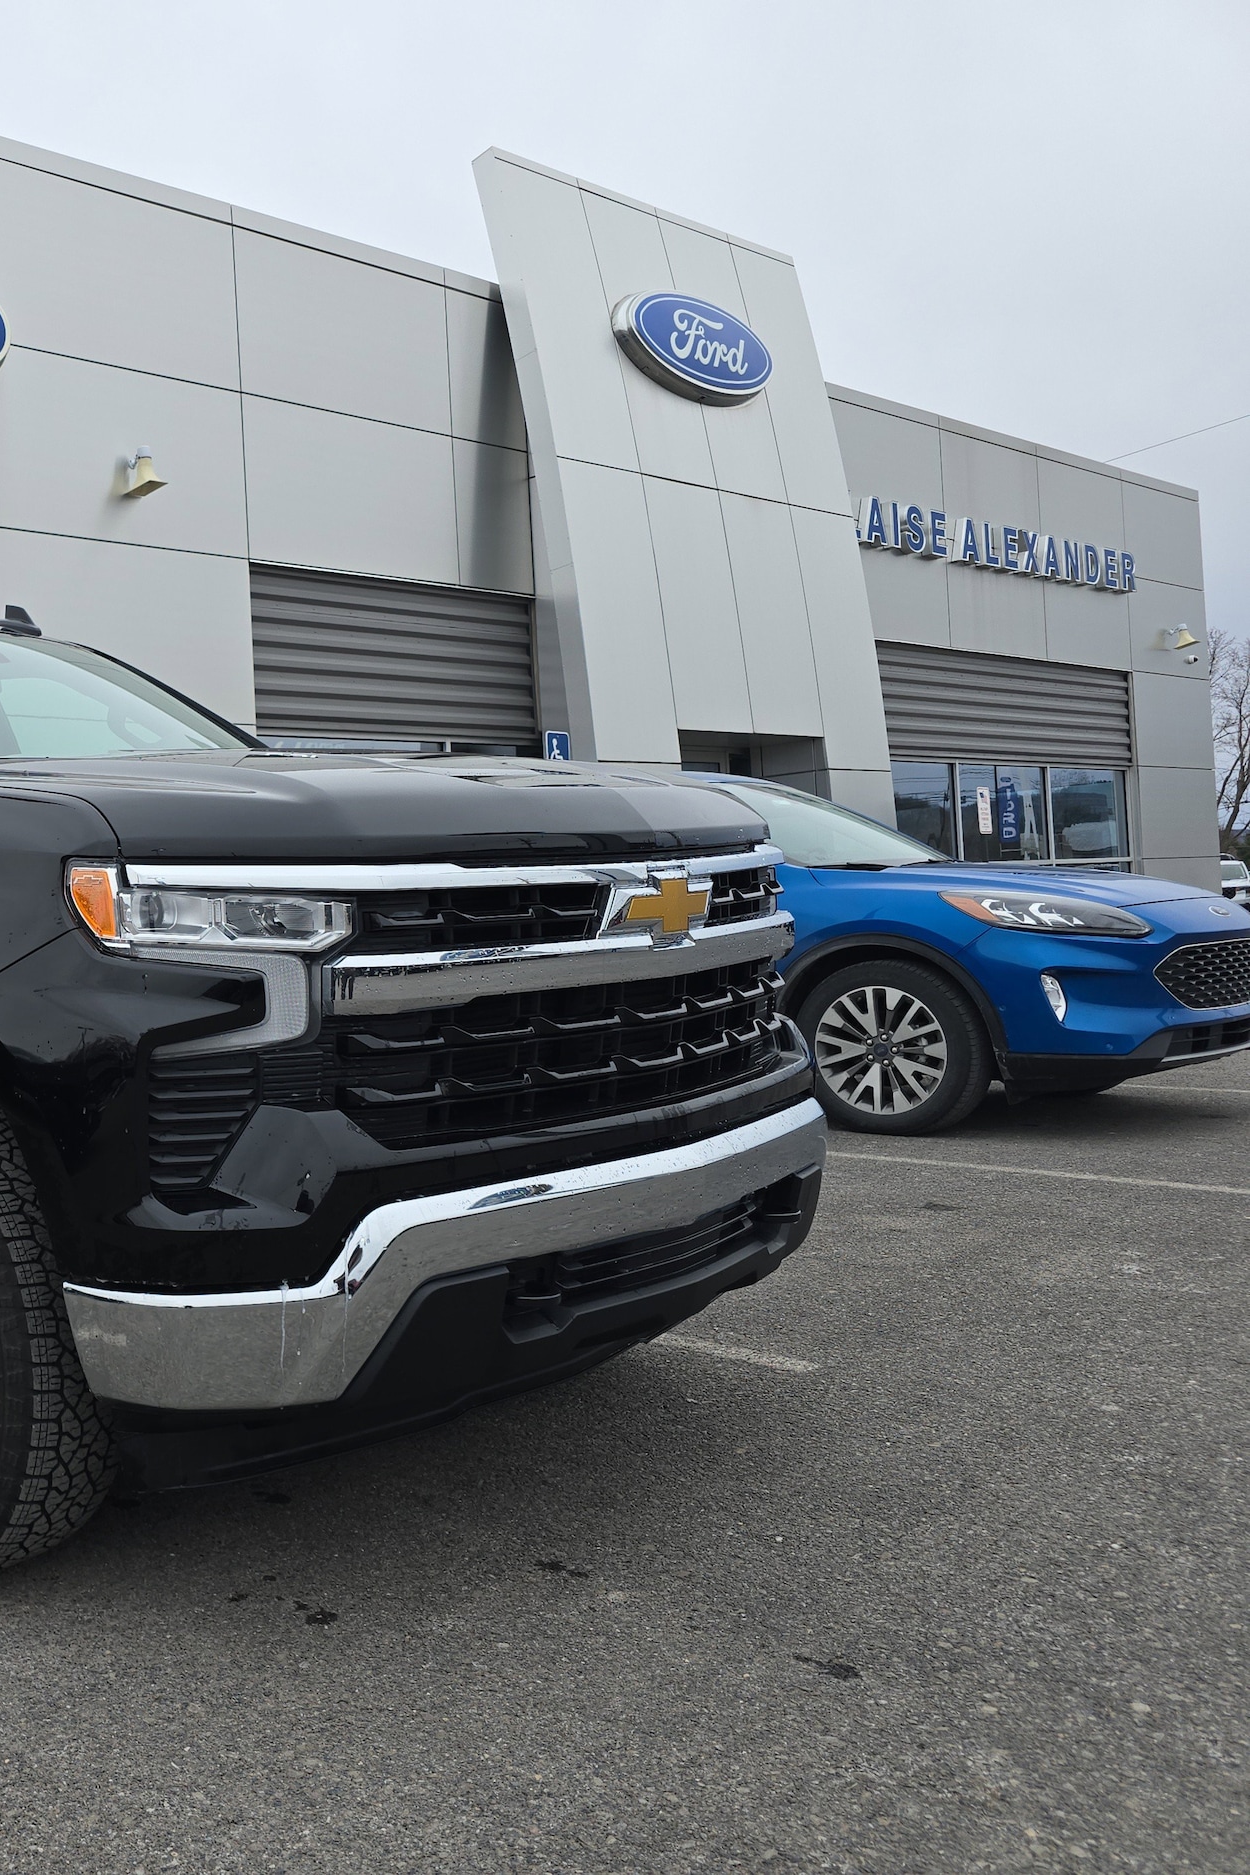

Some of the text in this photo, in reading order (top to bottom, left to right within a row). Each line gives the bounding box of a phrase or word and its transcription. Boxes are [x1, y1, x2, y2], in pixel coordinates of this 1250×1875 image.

[670, 308, 748, 375] Ford
[855, 495, 1136, 592] AISE ALEXANDER
